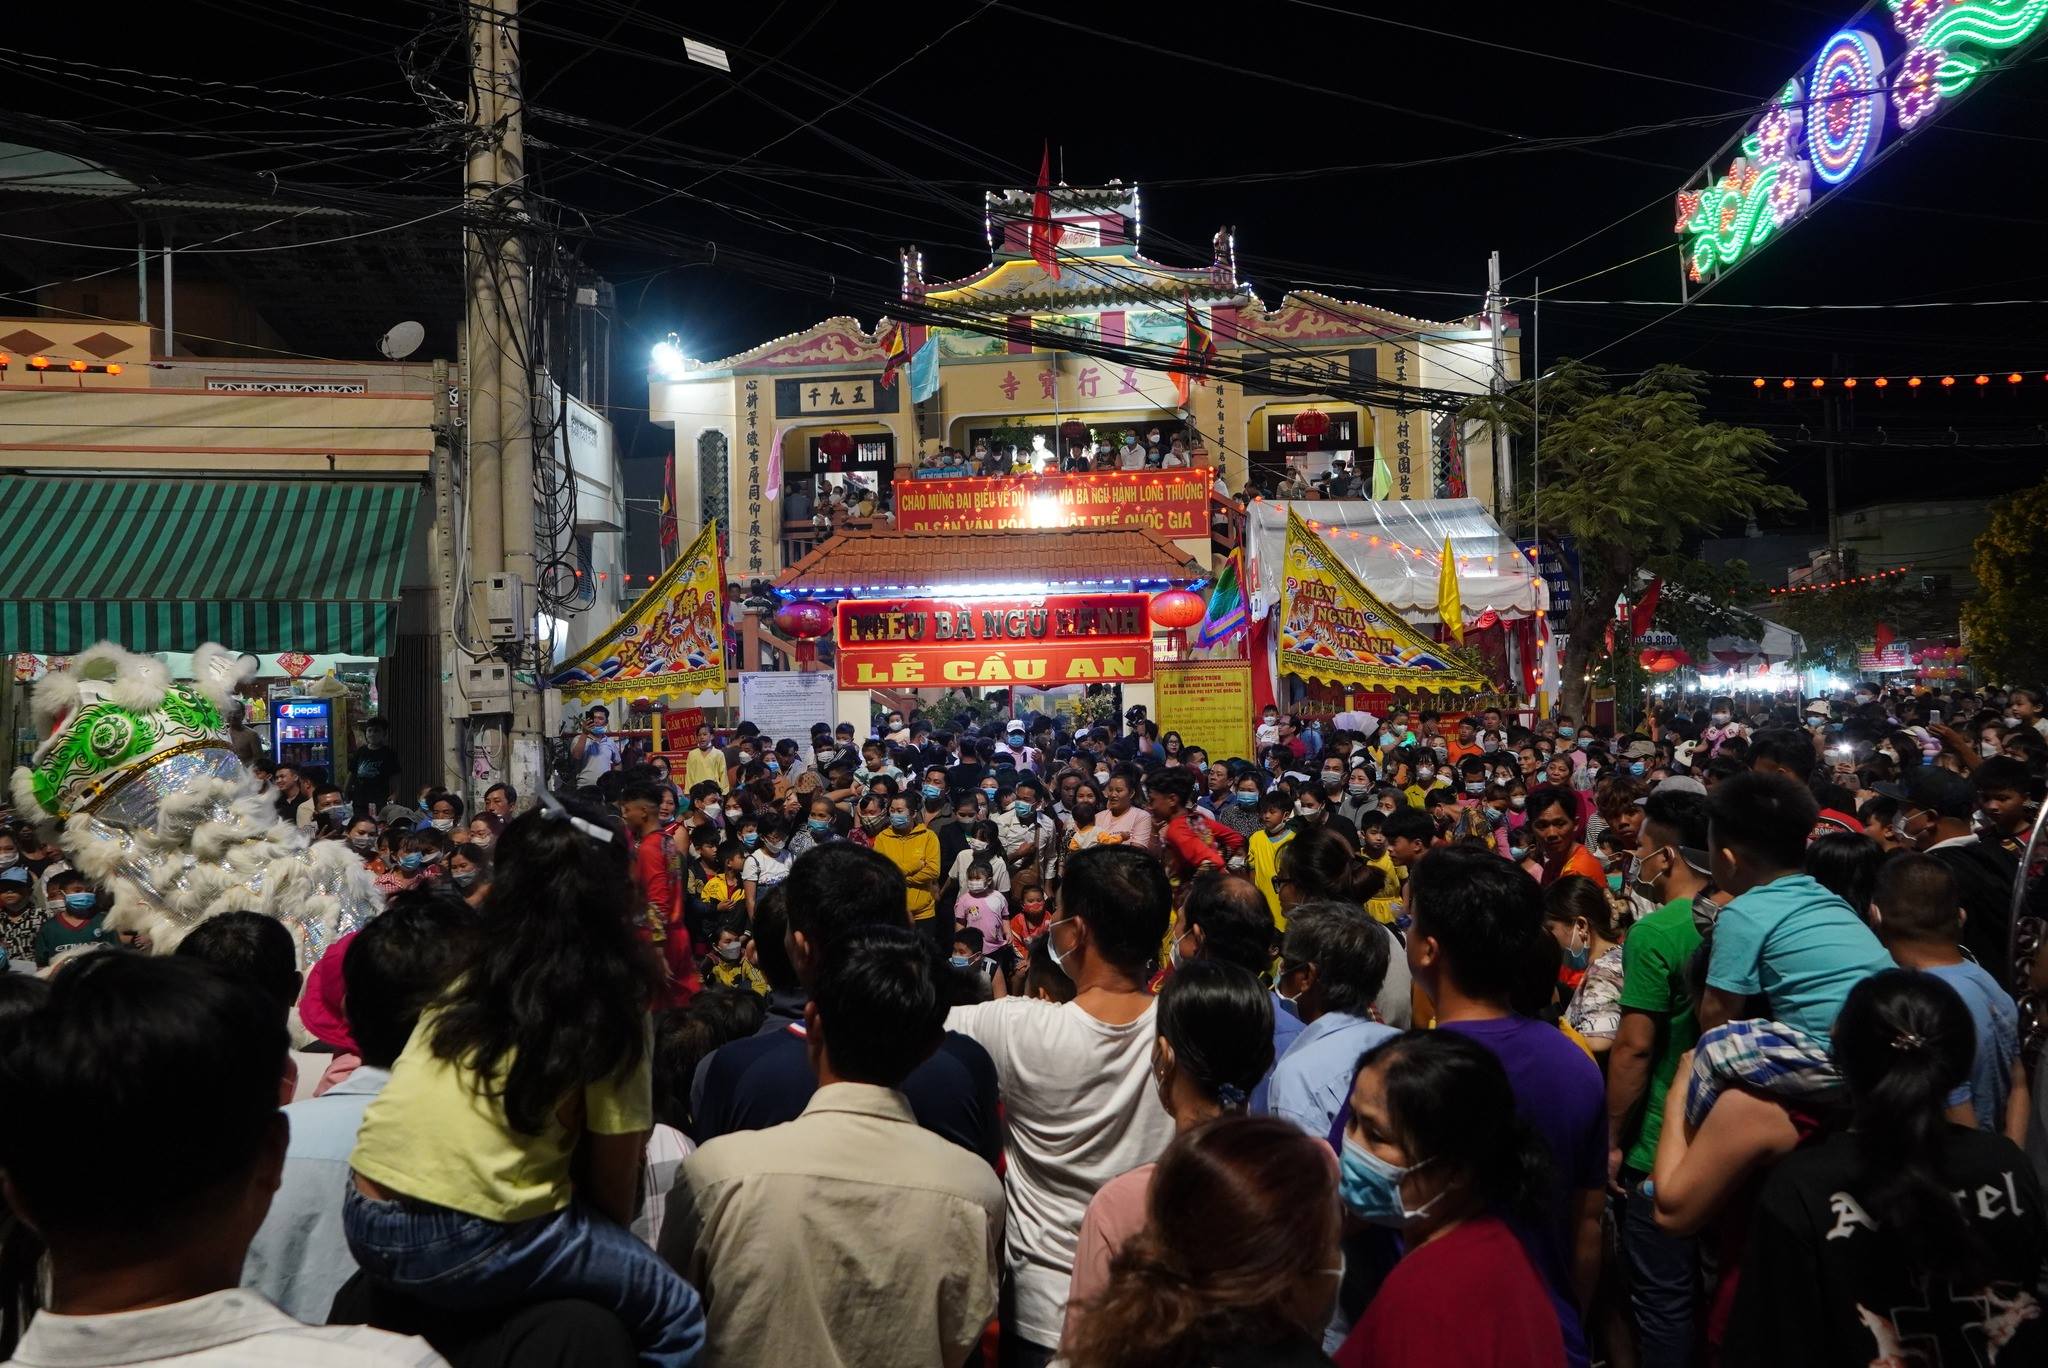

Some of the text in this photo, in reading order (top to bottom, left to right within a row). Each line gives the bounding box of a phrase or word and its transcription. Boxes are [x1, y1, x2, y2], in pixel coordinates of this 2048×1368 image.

[902, 490, 926, 511] CHÀO
[928, 489, 953, 511] MỪNG
[956, 492, 972, 513] ĐẠI
[974, 484, 996, 509] BIỂU
[997, 485, 1009, 507] VỀ
[1077, 482, 1089, 504] BÀ
[1092, 483, 1110, 503] NGŨ
[1112, 483, 1137, 503] HÀNH
[1140, 484, 1164, 502] LONG
[1166, 482, 1204, 504] THƯỢNG
[1168, 511, 1193, 530] GIA
[1301, 579, 1336, 603] LIÊN
[935, 605, 975, 640] BÀ
[982, 600, 1048, 639] NGŨ
[1055, 600, 1140, 637] HÀNH
[1317, 607, 1366, 630] NGHĨA
[857, 651, 1137, 683] LỄ CẦU AN
[294, 705, 321, 716] pepsi
[667, 715, 681, 731] CẤM
